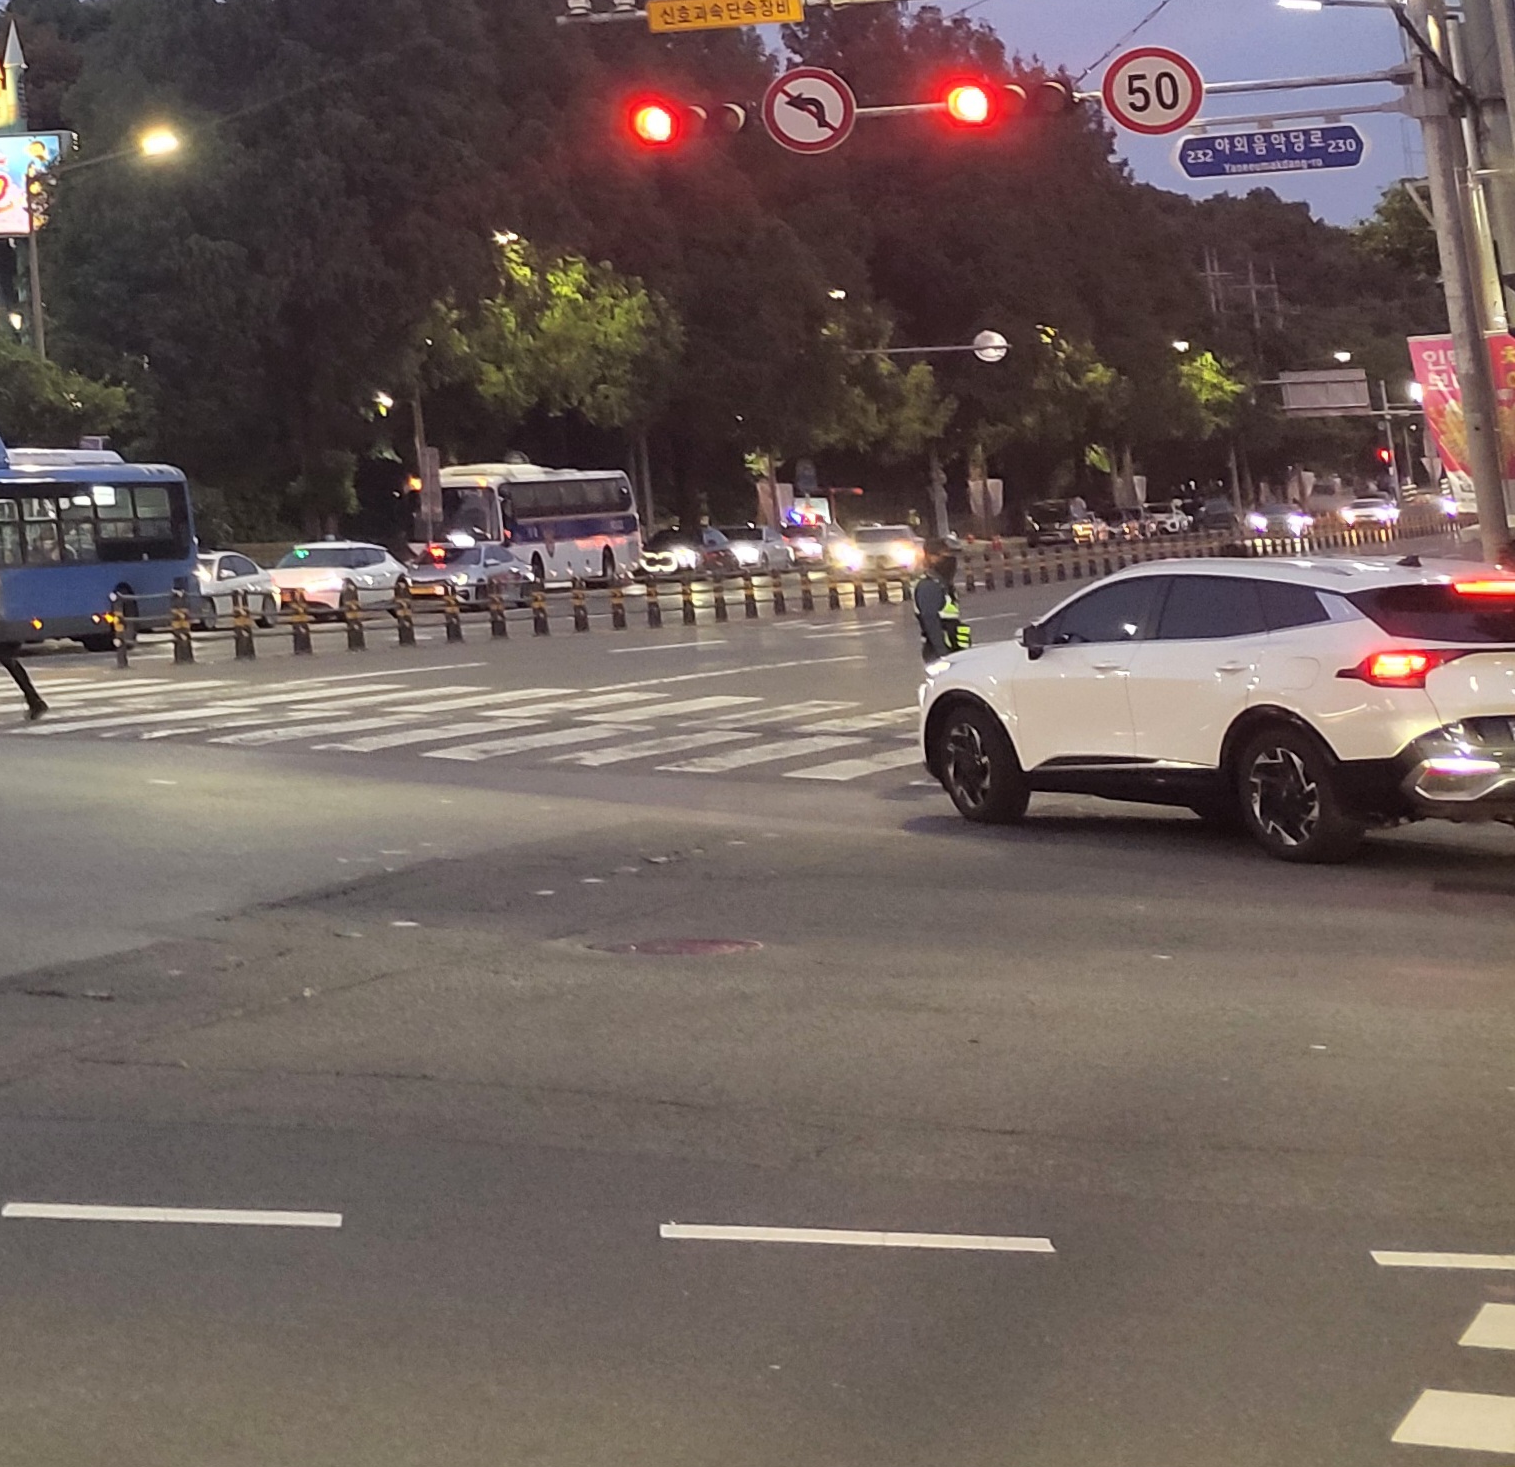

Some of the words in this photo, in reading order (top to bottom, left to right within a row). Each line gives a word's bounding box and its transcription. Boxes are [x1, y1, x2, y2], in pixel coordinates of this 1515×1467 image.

[1128, 71, 1179, 113] 50
[1186, 149, 1214, 164] 232
[1214, 130, 1326, 155] 야외음악당로
[1327, 138, 1357, 153] 230
